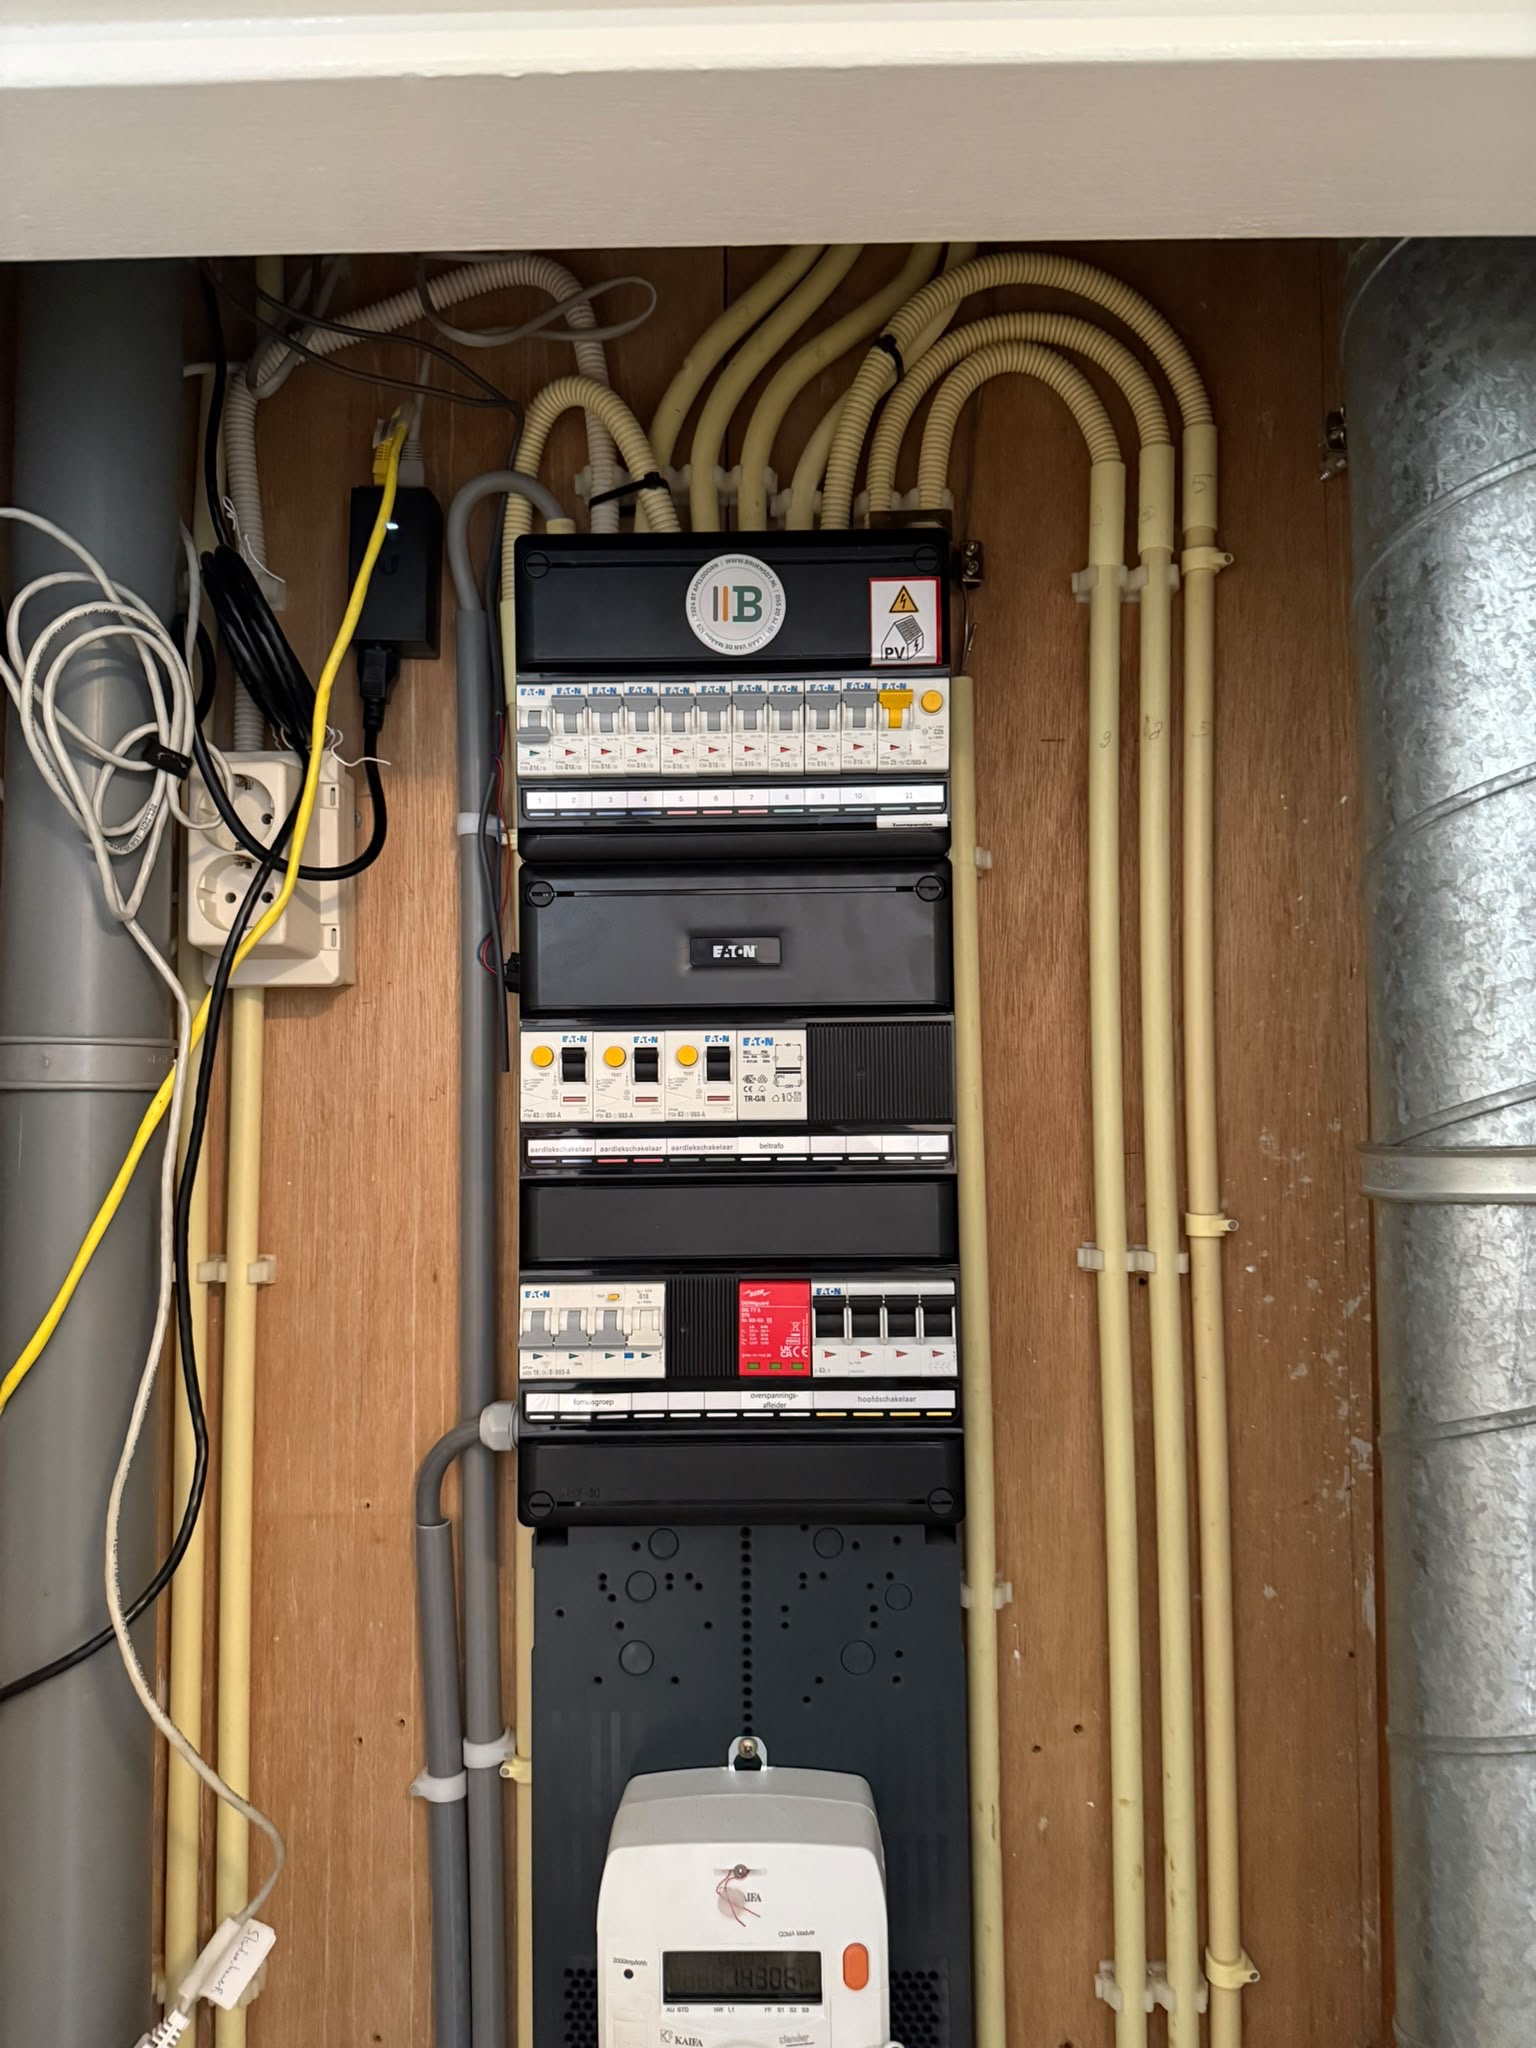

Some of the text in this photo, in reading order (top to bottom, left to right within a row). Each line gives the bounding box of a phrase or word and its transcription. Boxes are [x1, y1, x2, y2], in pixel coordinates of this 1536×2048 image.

[885, 647, 905, 660] PV
[712, 945, 756, 958] EATON
[562, 1035, 588, 1043] EATON
[633, 1036, 659, 1044] EATON
[705, 1035, 730, 1043] EATON
[743, 1037, 774, 1046] EATON
[530, 1146, 593, 1154] aardlekschakelaar
[600, 1145, 663, 1153] aardlekschakelaar
[671, 1144, 734, 1152] aardlekschakelaar
[759, 1142, 784, 1150] beltrafo
[525, 1291, 550, 1299] EATON
[816, 1288, 841, 1296] EATON
[750, 1392, 799, 1401] overspannings-
[675, 2036, 704, 2048] KAIFA
